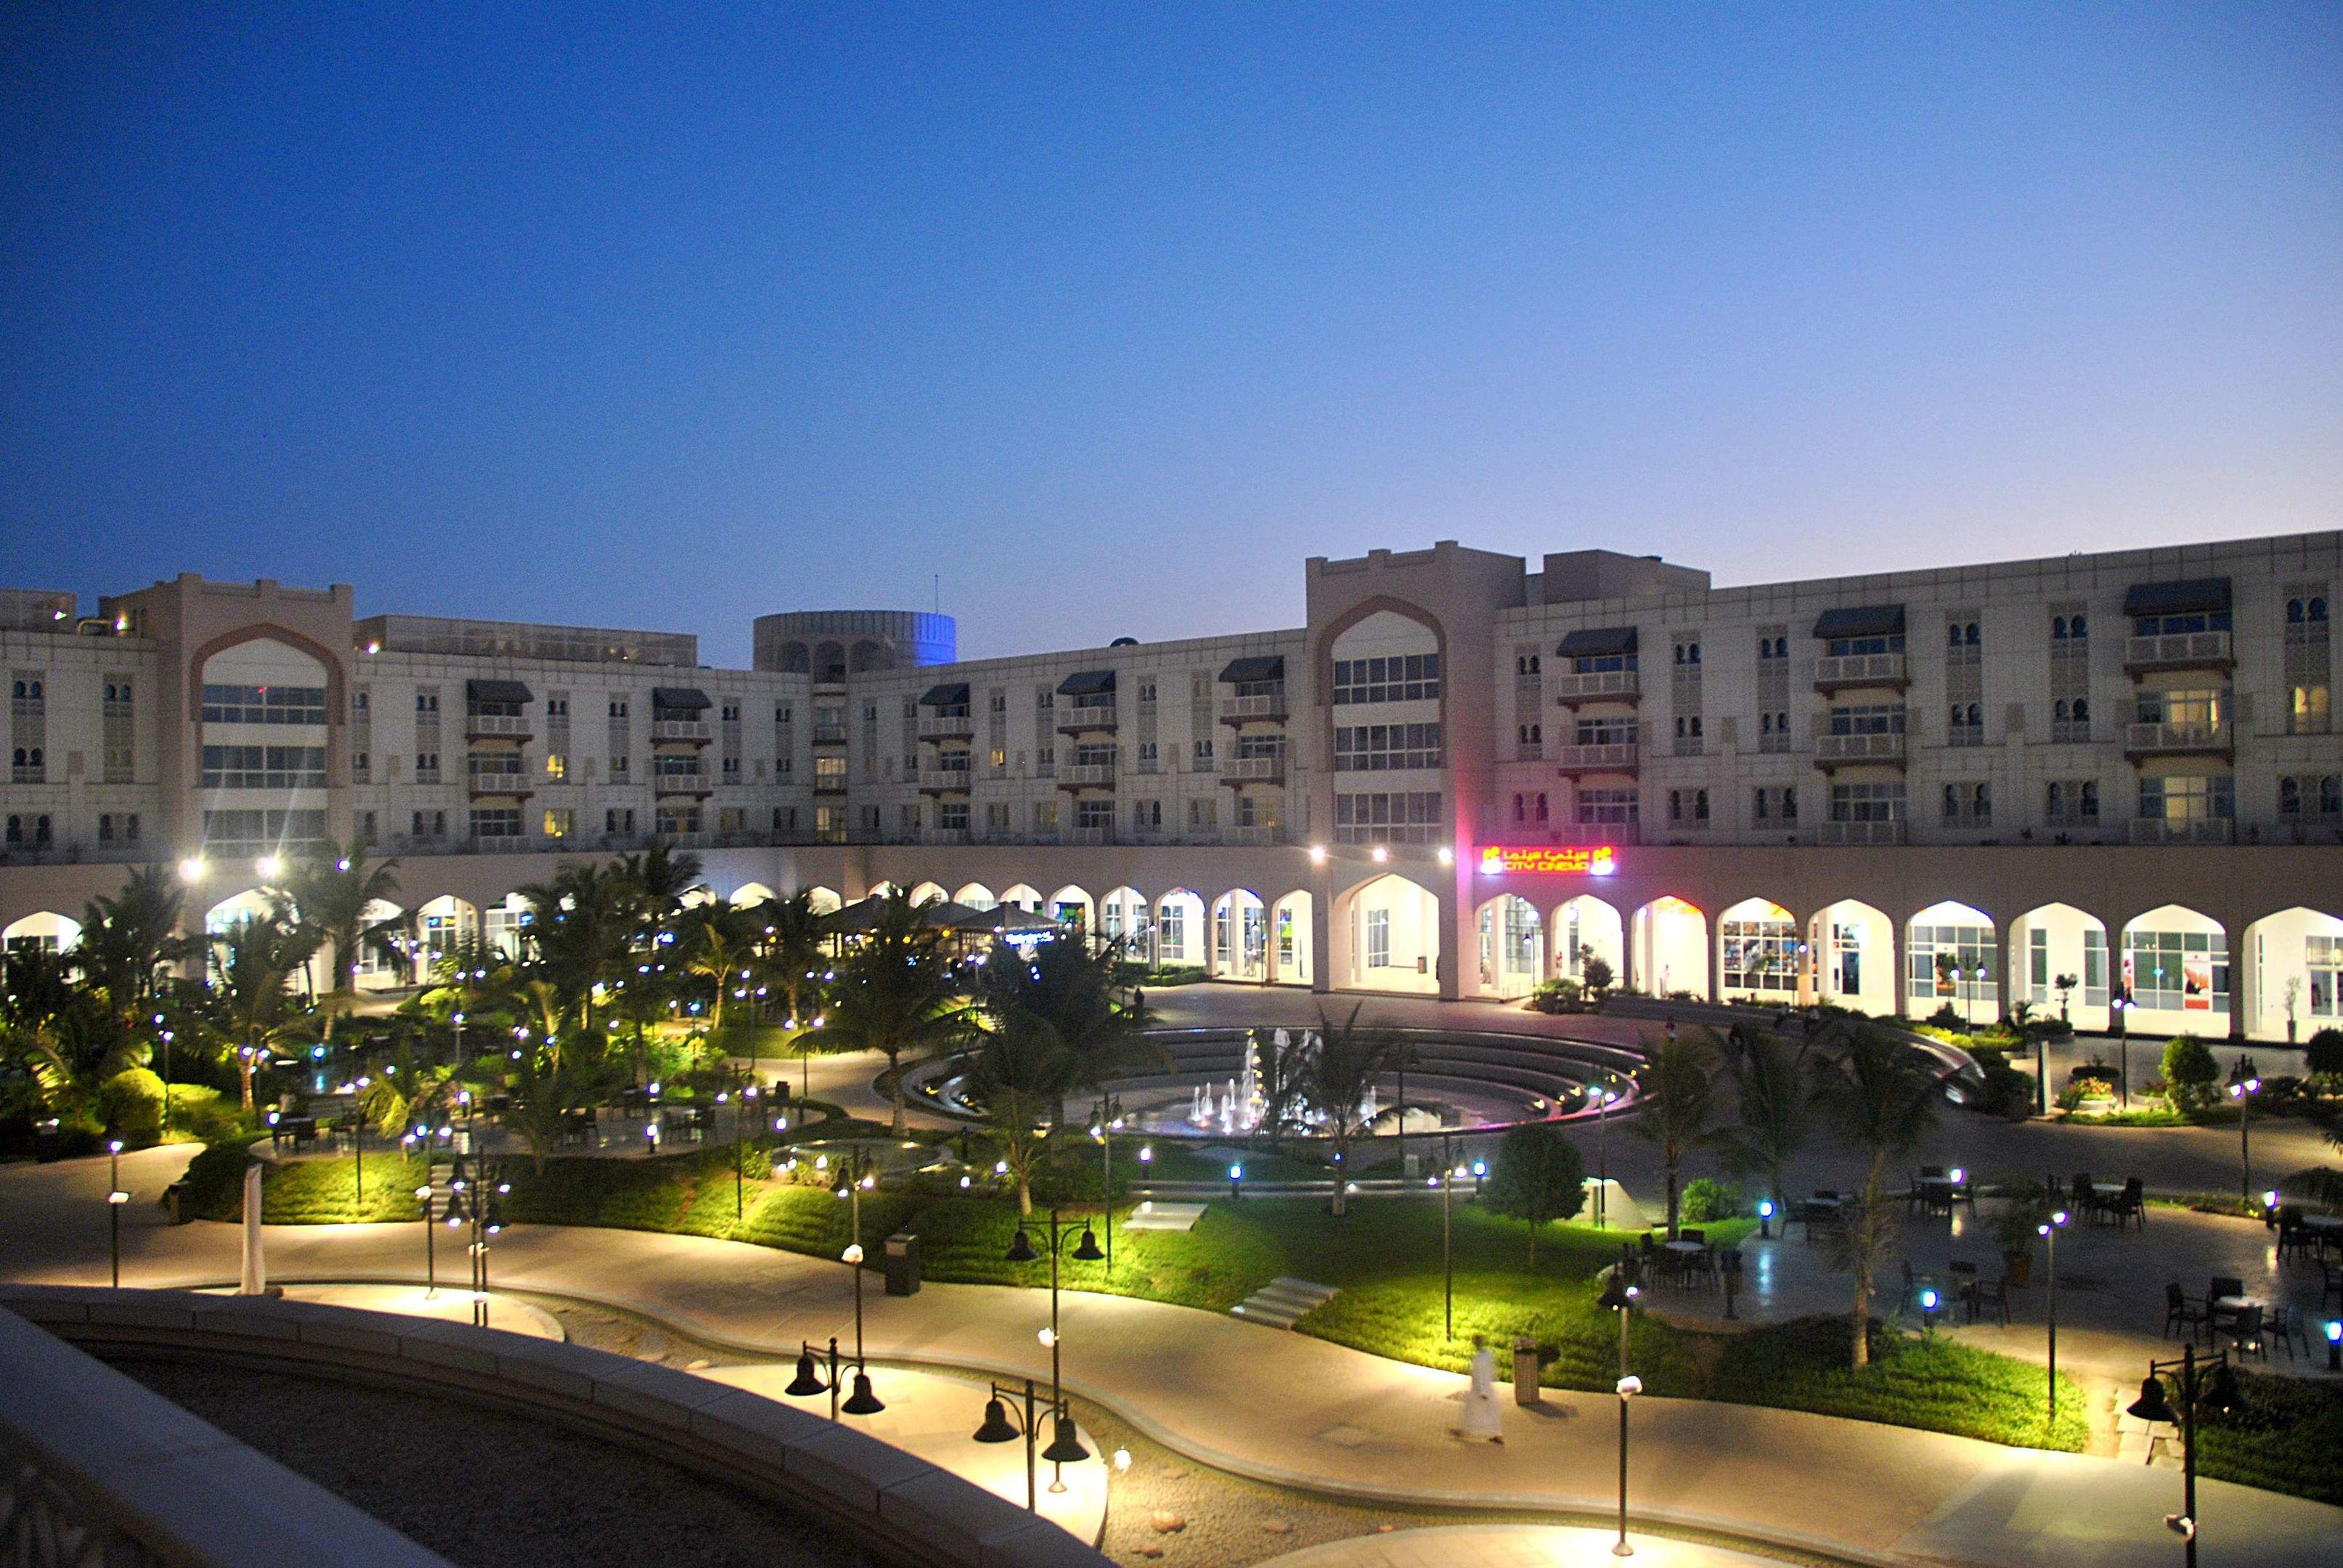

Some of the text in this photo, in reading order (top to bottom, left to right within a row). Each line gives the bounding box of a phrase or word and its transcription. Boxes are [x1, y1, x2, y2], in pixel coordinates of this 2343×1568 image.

[1503, 849, 1541, 862] سينما
[1504, 861, 1589, 871] CITY CINEMA
